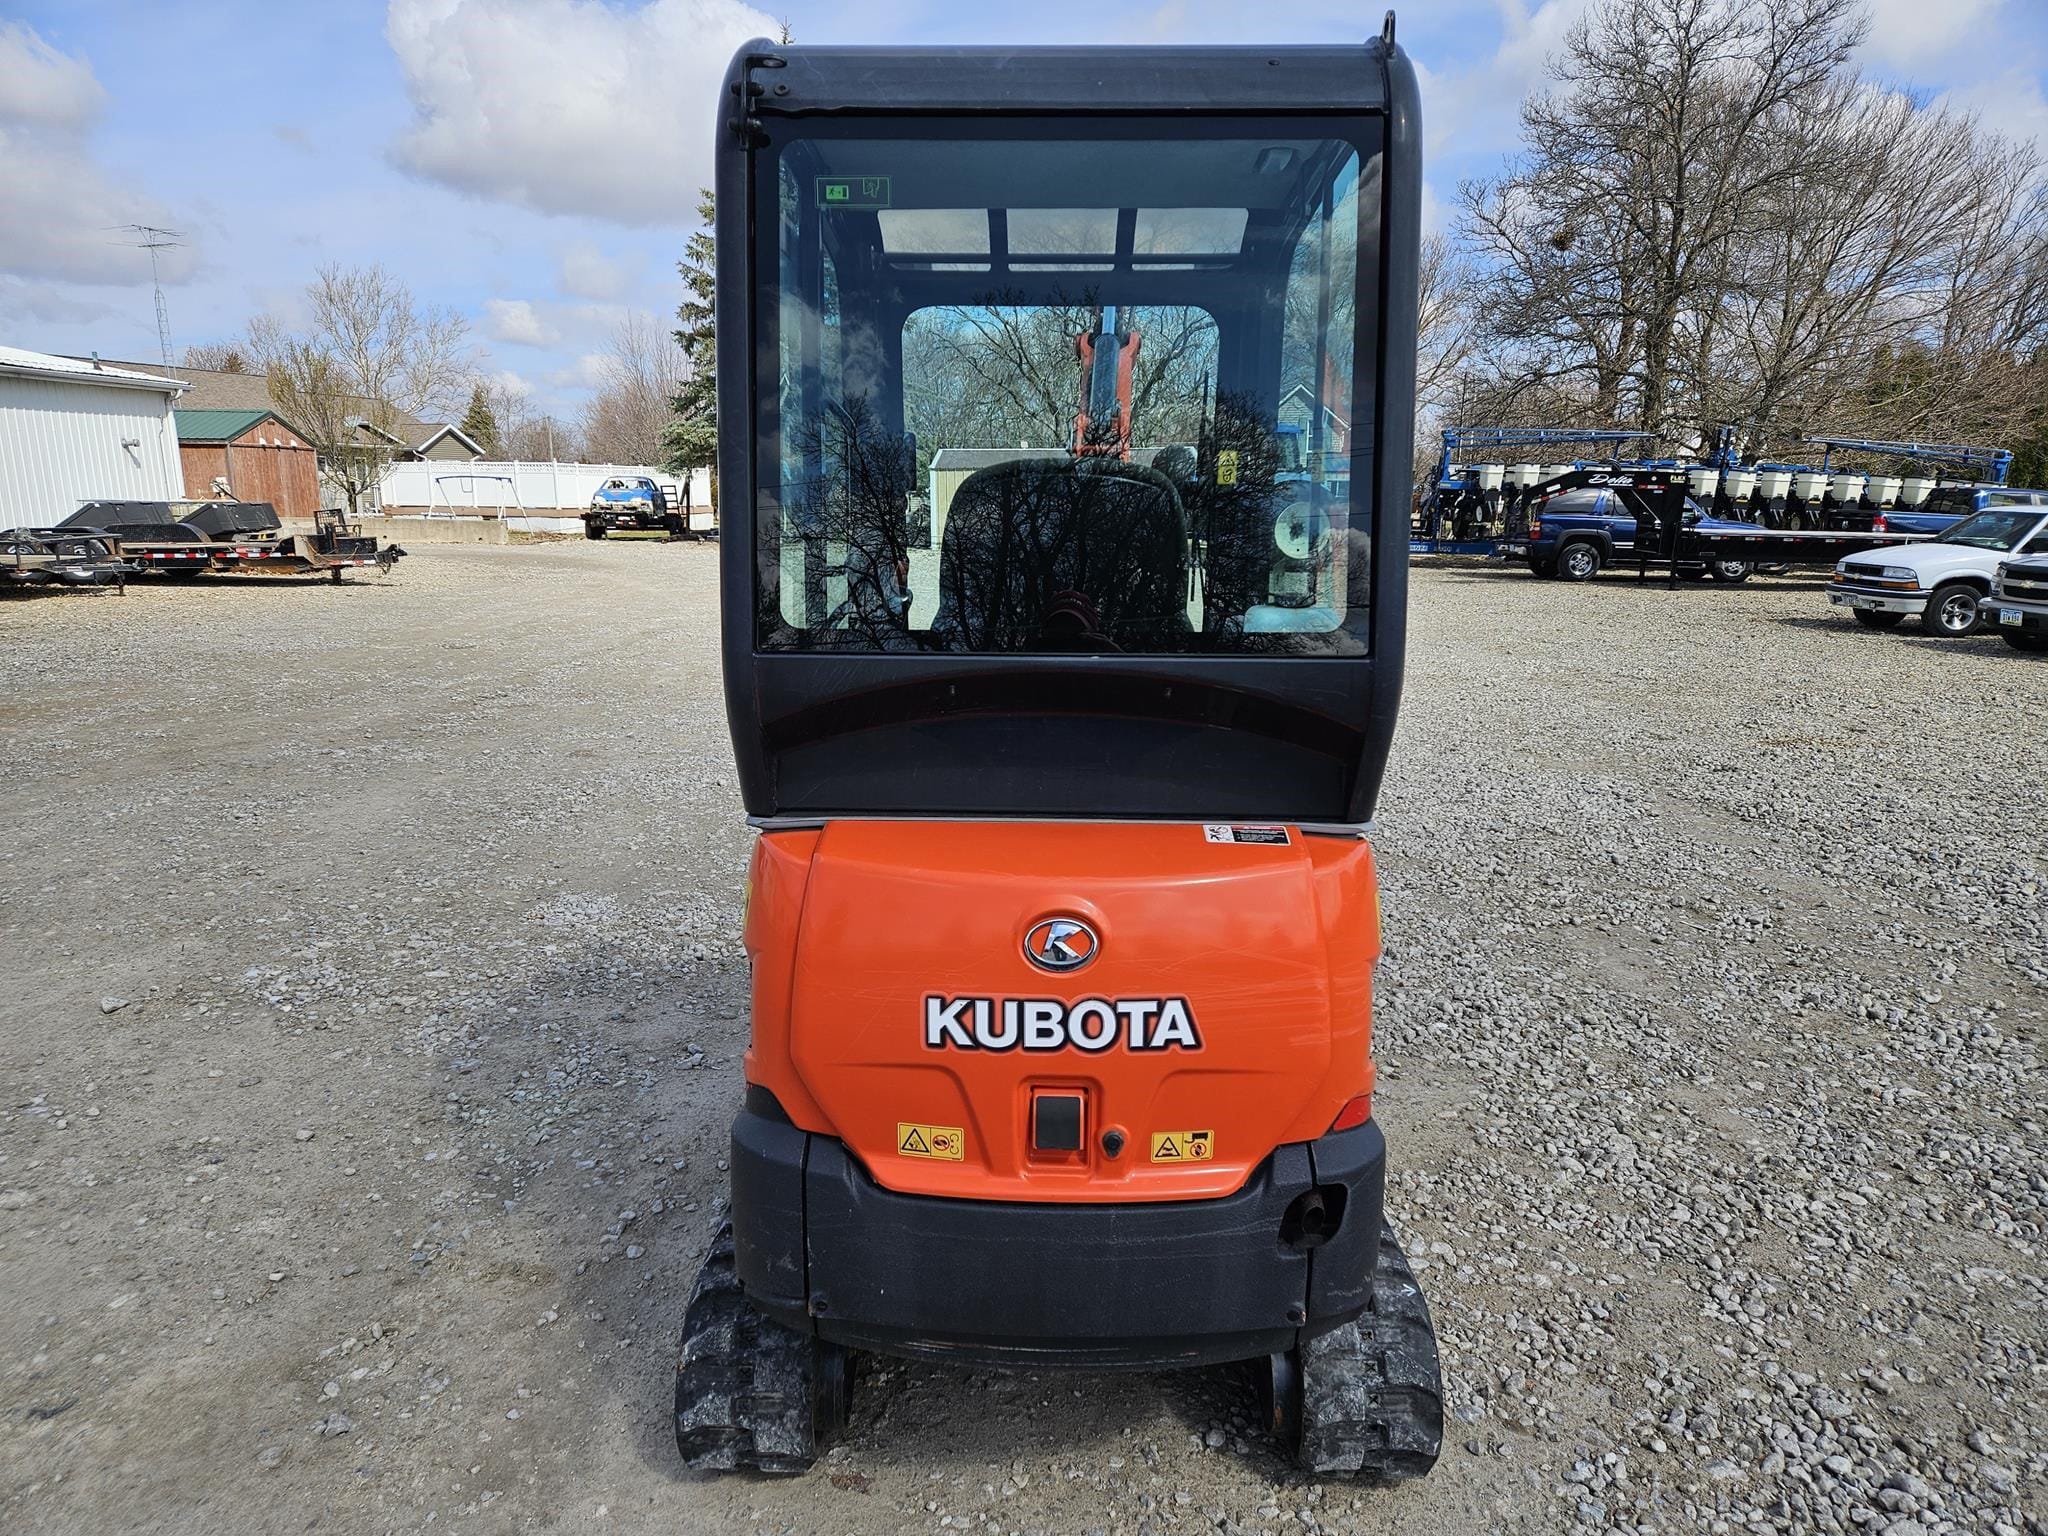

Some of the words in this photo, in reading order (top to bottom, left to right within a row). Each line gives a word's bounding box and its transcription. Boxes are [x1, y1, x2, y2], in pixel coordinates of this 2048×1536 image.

[1588, 474, 1633, 484] Delta
[1041, 920, 1084, 962] K
[925, 996, 1198, 1050] KUBOTA
